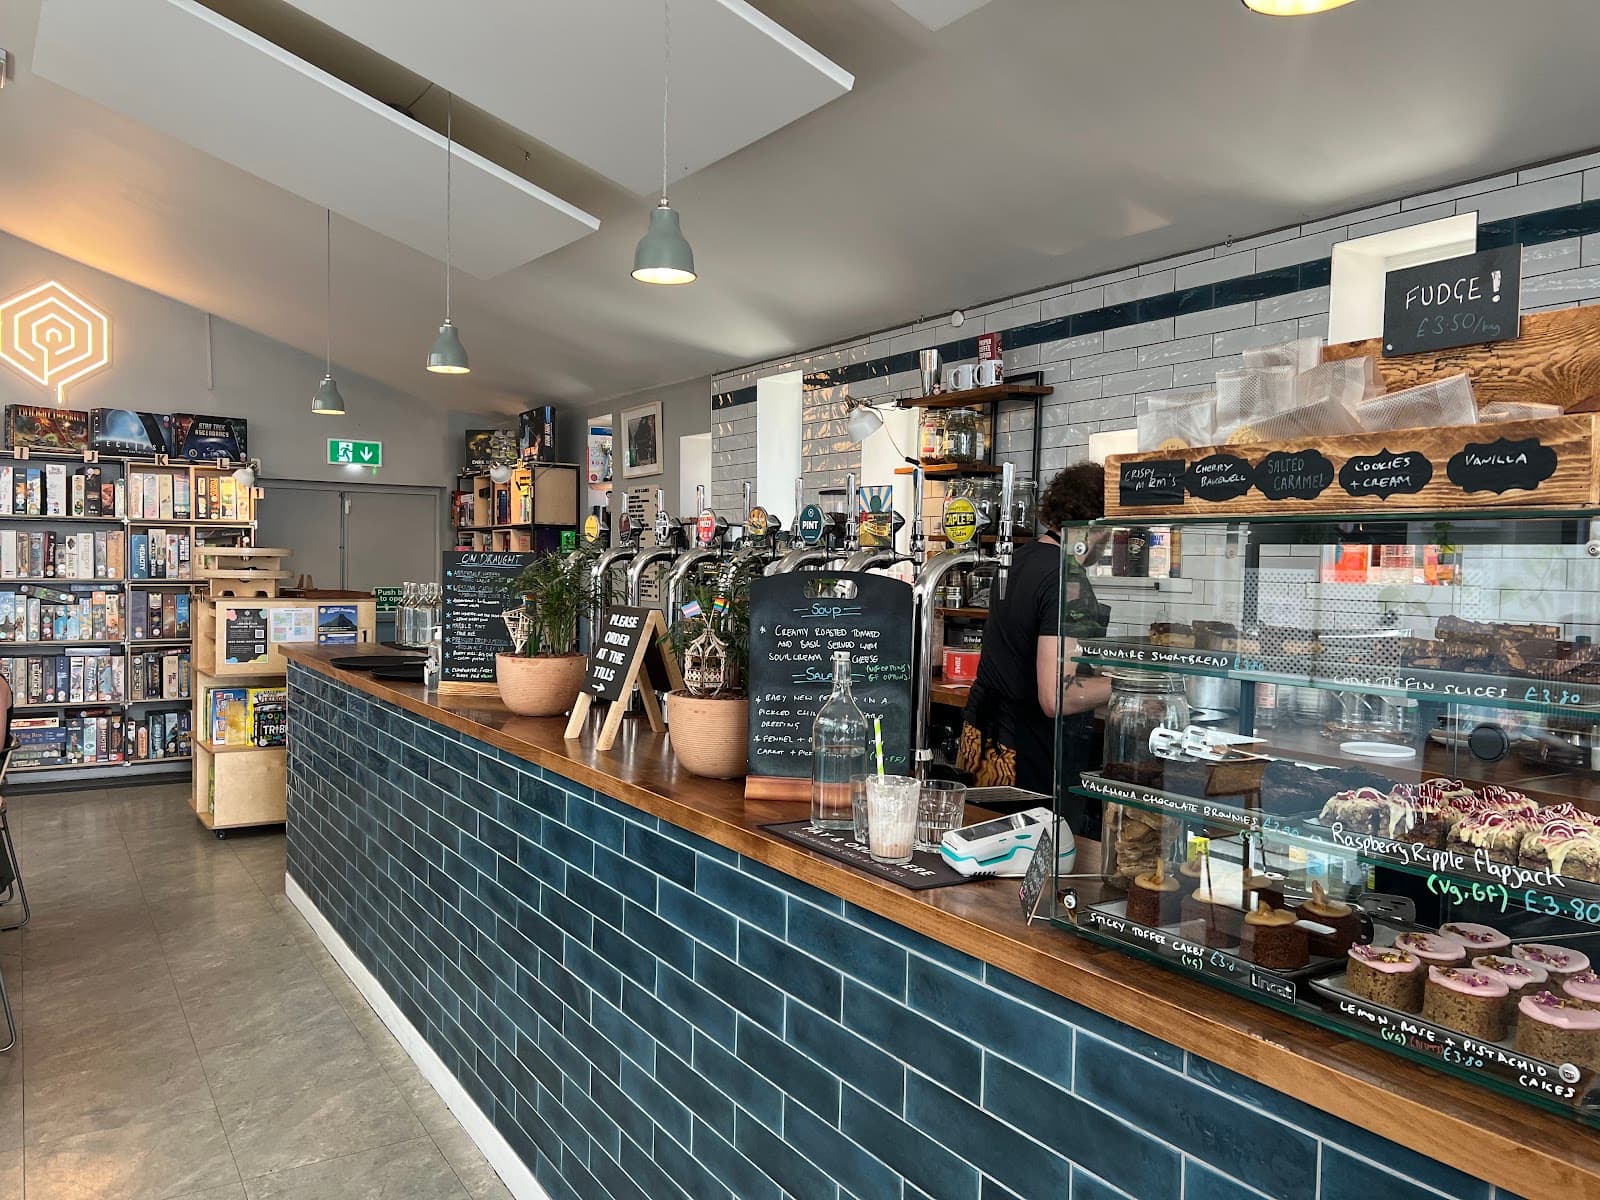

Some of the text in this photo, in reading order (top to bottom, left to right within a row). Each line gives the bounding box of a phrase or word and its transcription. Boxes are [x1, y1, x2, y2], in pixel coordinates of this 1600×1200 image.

[1405, 276, 1482, 310] FUDGE
[199, 422, 226, 431] STAR TREK
[157, 454, 168, 466] K
[219, 458, 227, 468] L
[1267, 457, 1305, 474] SALTED
[1354, 456, 1412, 472] COOKIES
[1465, 453, 1528, 466] VANILLA
[1124, 467, 1155, 482] CRISPY
[1195, 462, 1234, 474] CHERRY
[1200, 473, 1247, 488] BAKEWELL
[1273, 473, 1325, 491] CARAMEL
[1362, 475, 1412, 489] CREAM
[802, 520, 819, 530] PINT
[461, 553, 524, 567] ON DRAUGHT
[811, 602, 842, 620] Soup
[609, 613, 640, 629] PLEASE
[774, 624, 881, 638] CREAMY ROASTED TOMATO
[604, 631, 631, 647] ORDER
[777, 641, 793, 649] AND
[800, 640, 821, 649] BASIL
[827, 640, 856, 650] SERVED
[595, 647, 626, 666] AT THE
[768, 652, 793, 662] SOUR
[793, 653, 823, 662] CREAM
[851, 654, 879, 664] CHEESE
[1074, 644, 1145, 661] MILLIONAIRE
[1151, 651, 1229, 667] SHORTBREAD
[592, 665, 616, 682] TILLS
[805, 666, 833, 681] SALA
[1443, 684, 1508, 698] SLICES
[765, 694, 787, 702] BABY
[863, 696, 876, 704] IN
[758, 708, 791, 717] PICKLED
[796, 709, 817, 717] CHIL
[262, 724, 286, 735] TRIB
[760, 721, 801, 730] DRESSING
[762, 735, 793, 743] FENNEL
[756, 747, 785, 756] CARROT
[1081, 779, 1137, 800] VALRHONA
[1142, 793, 1199, 813] CHOCOLATE
[1203, 806, 1259, 826] BROWNIES
[801, 825, 836, 837] PAY
[844, 842, 872, 854] ORD
[896, 862, 937, 877] ERE
[1331, 821, 1410, 865] Raspberry
[1411, 842, 1465, 872] Ripple
[1524, 889, 1600, 924] £3.80
[1089, 912, 1126, 934] STICKY
[1131, 926, 1166, 946] TOFFEE
[1172, 941, 1205, 958] CAKES
[1400, 1020, 1436, 1042] ROSE
[1463, 1040, 1547, 1077] PISTACHIO
[1442, 1046, 1484, 1069] £3.80
[1518, 1074, 1577, 1099] CAKES
